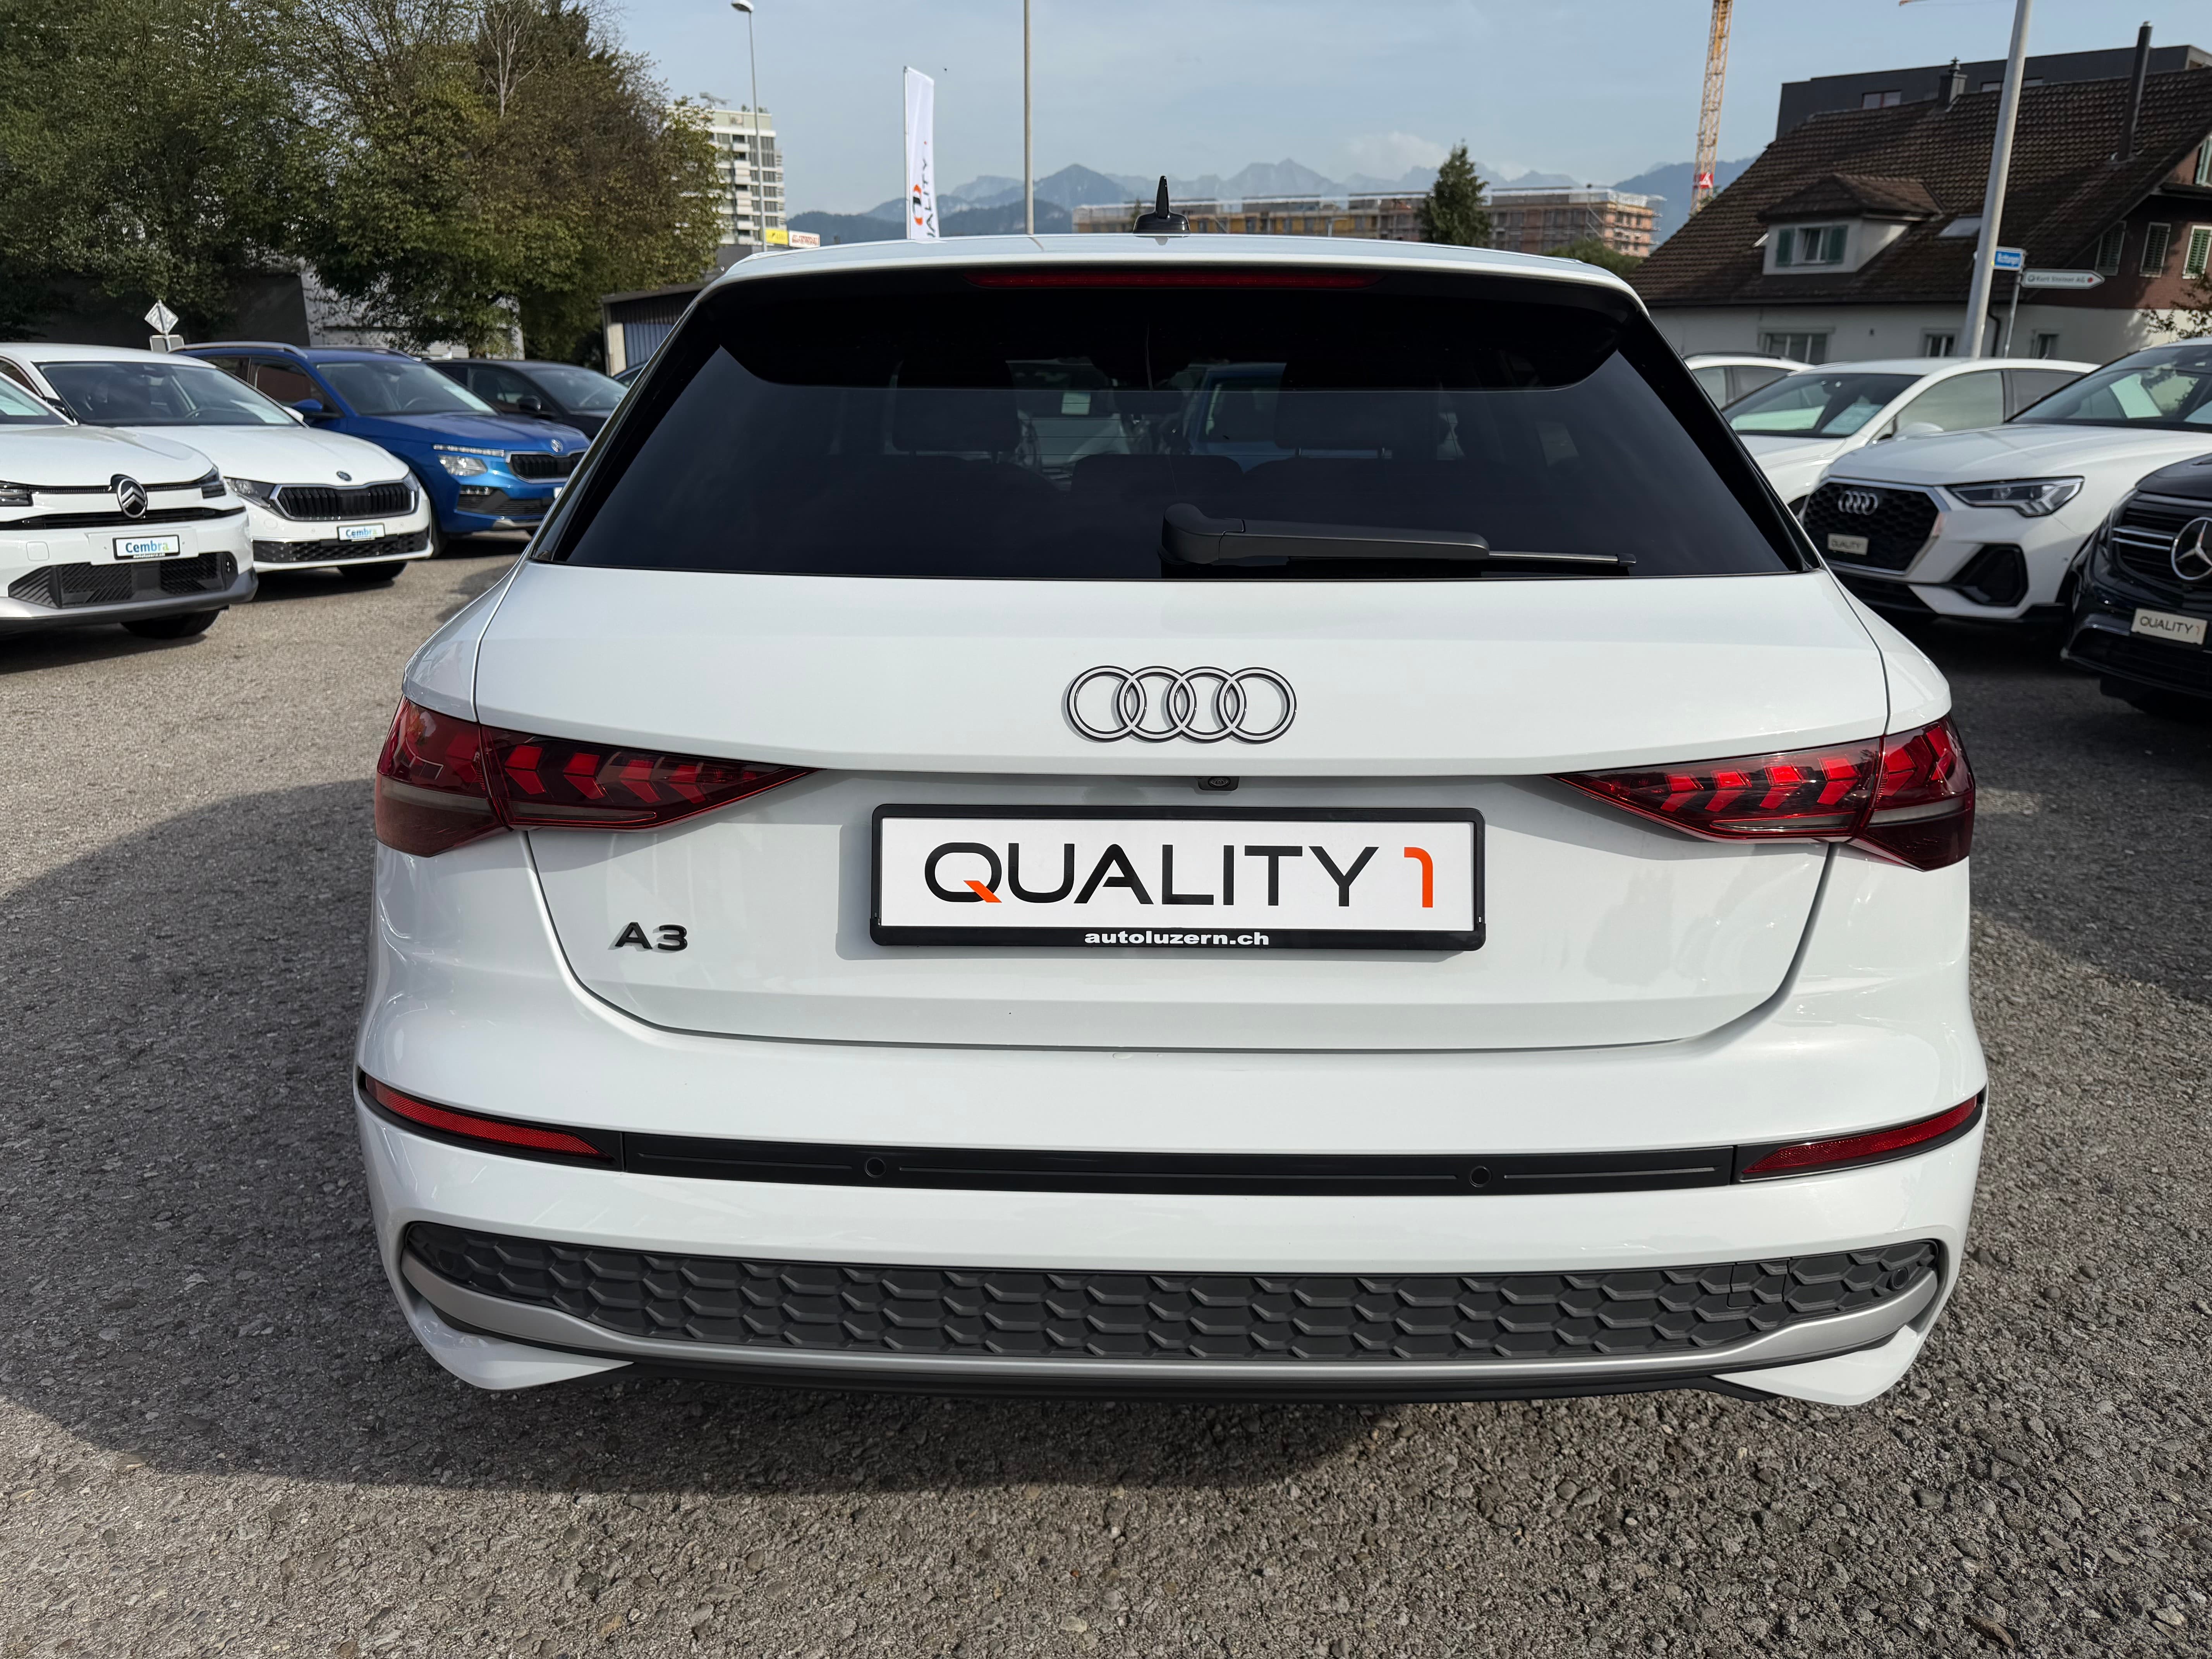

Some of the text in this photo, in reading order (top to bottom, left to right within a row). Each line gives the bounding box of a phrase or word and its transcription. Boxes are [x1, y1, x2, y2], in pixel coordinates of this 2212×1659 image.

[346, 526, 377, 537] Cembra
[125, 540, 169, 553] Cembra
[2140, 616, 2193, 634] QUALITY
[925, 843, 1433, 908] QUALITY 1
[615, 922, 688, 951] A3
[1085, 931, 1269, 945] autoluzern.ch
